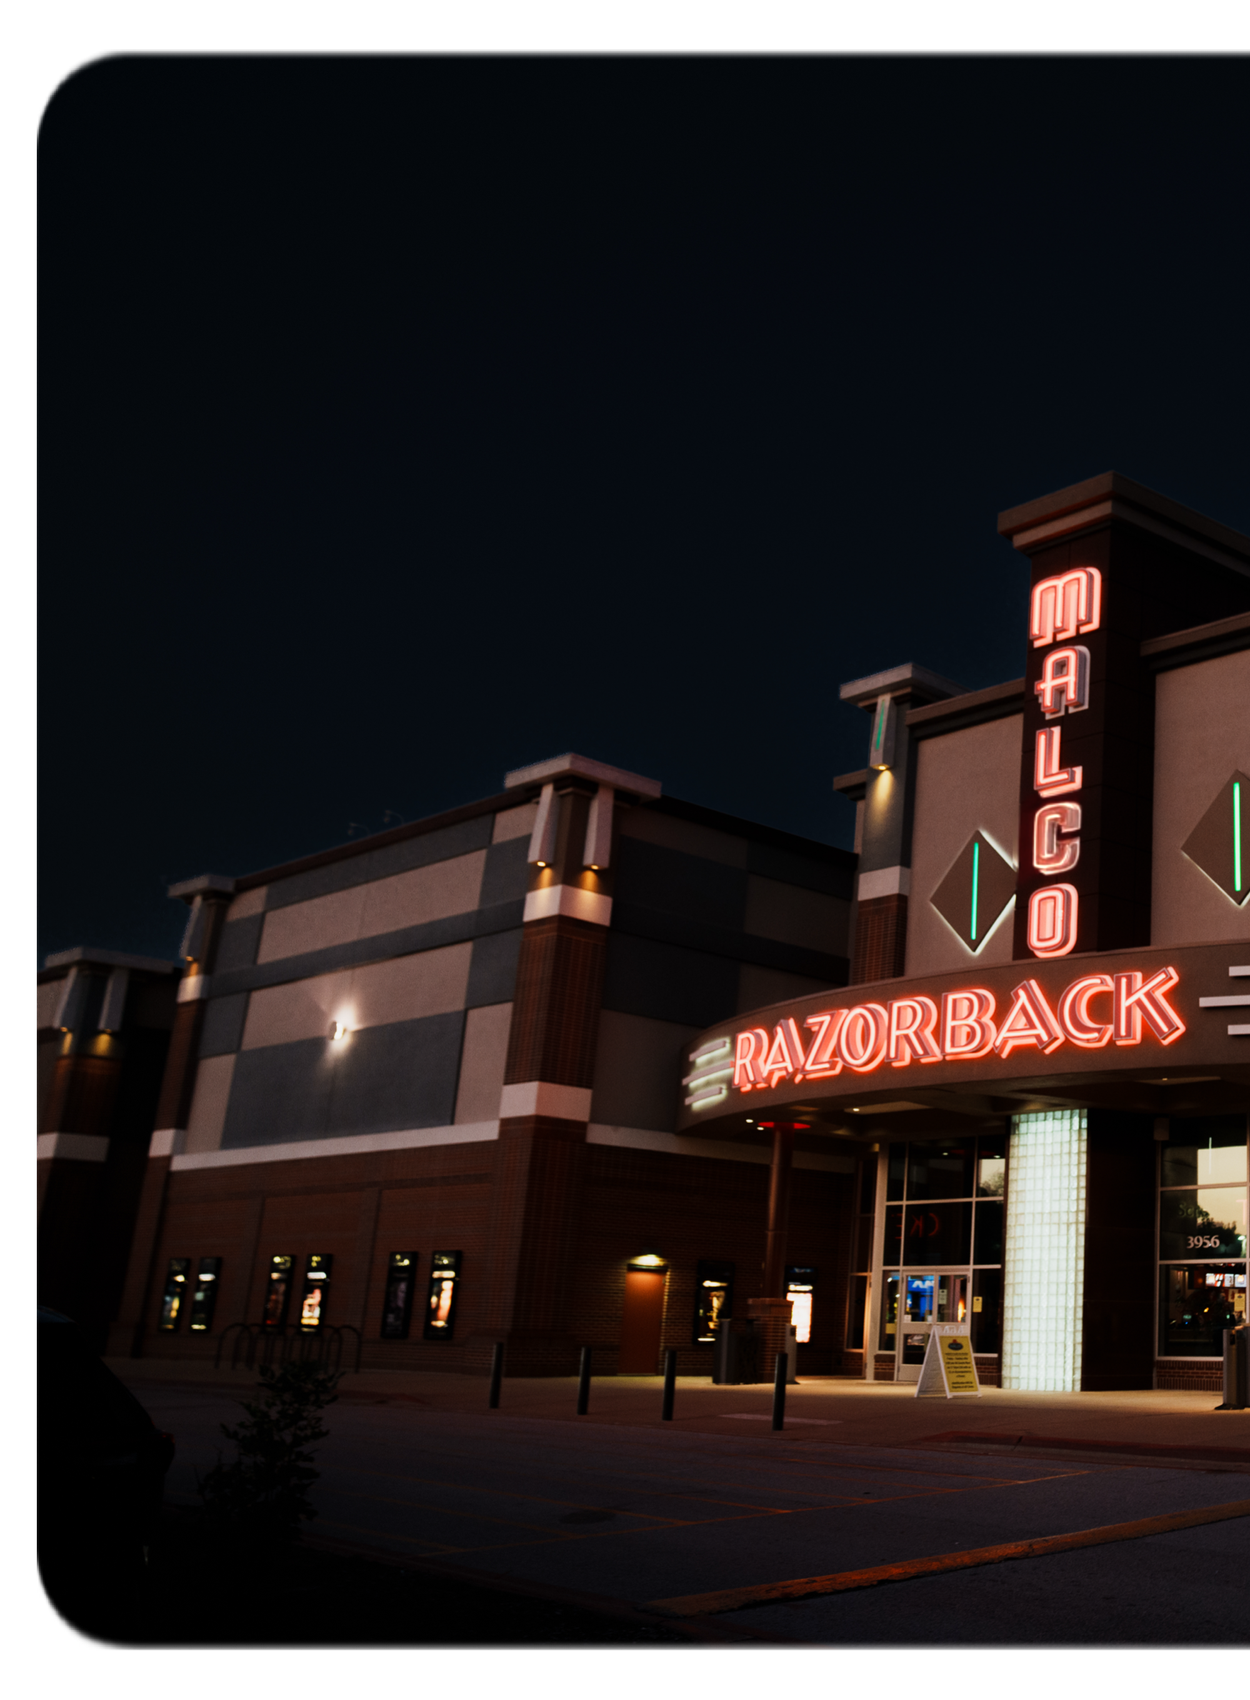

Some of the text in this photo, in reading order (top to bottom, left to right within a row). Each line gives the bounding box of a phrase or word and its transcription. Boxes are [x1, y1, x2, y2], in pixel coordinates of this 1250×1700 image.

[1027, 567, 1101, 958] MALCO
[731, 966, 1186, 1092] RAZORBACK
[1186, 1235, 1220, 1249] 3956
